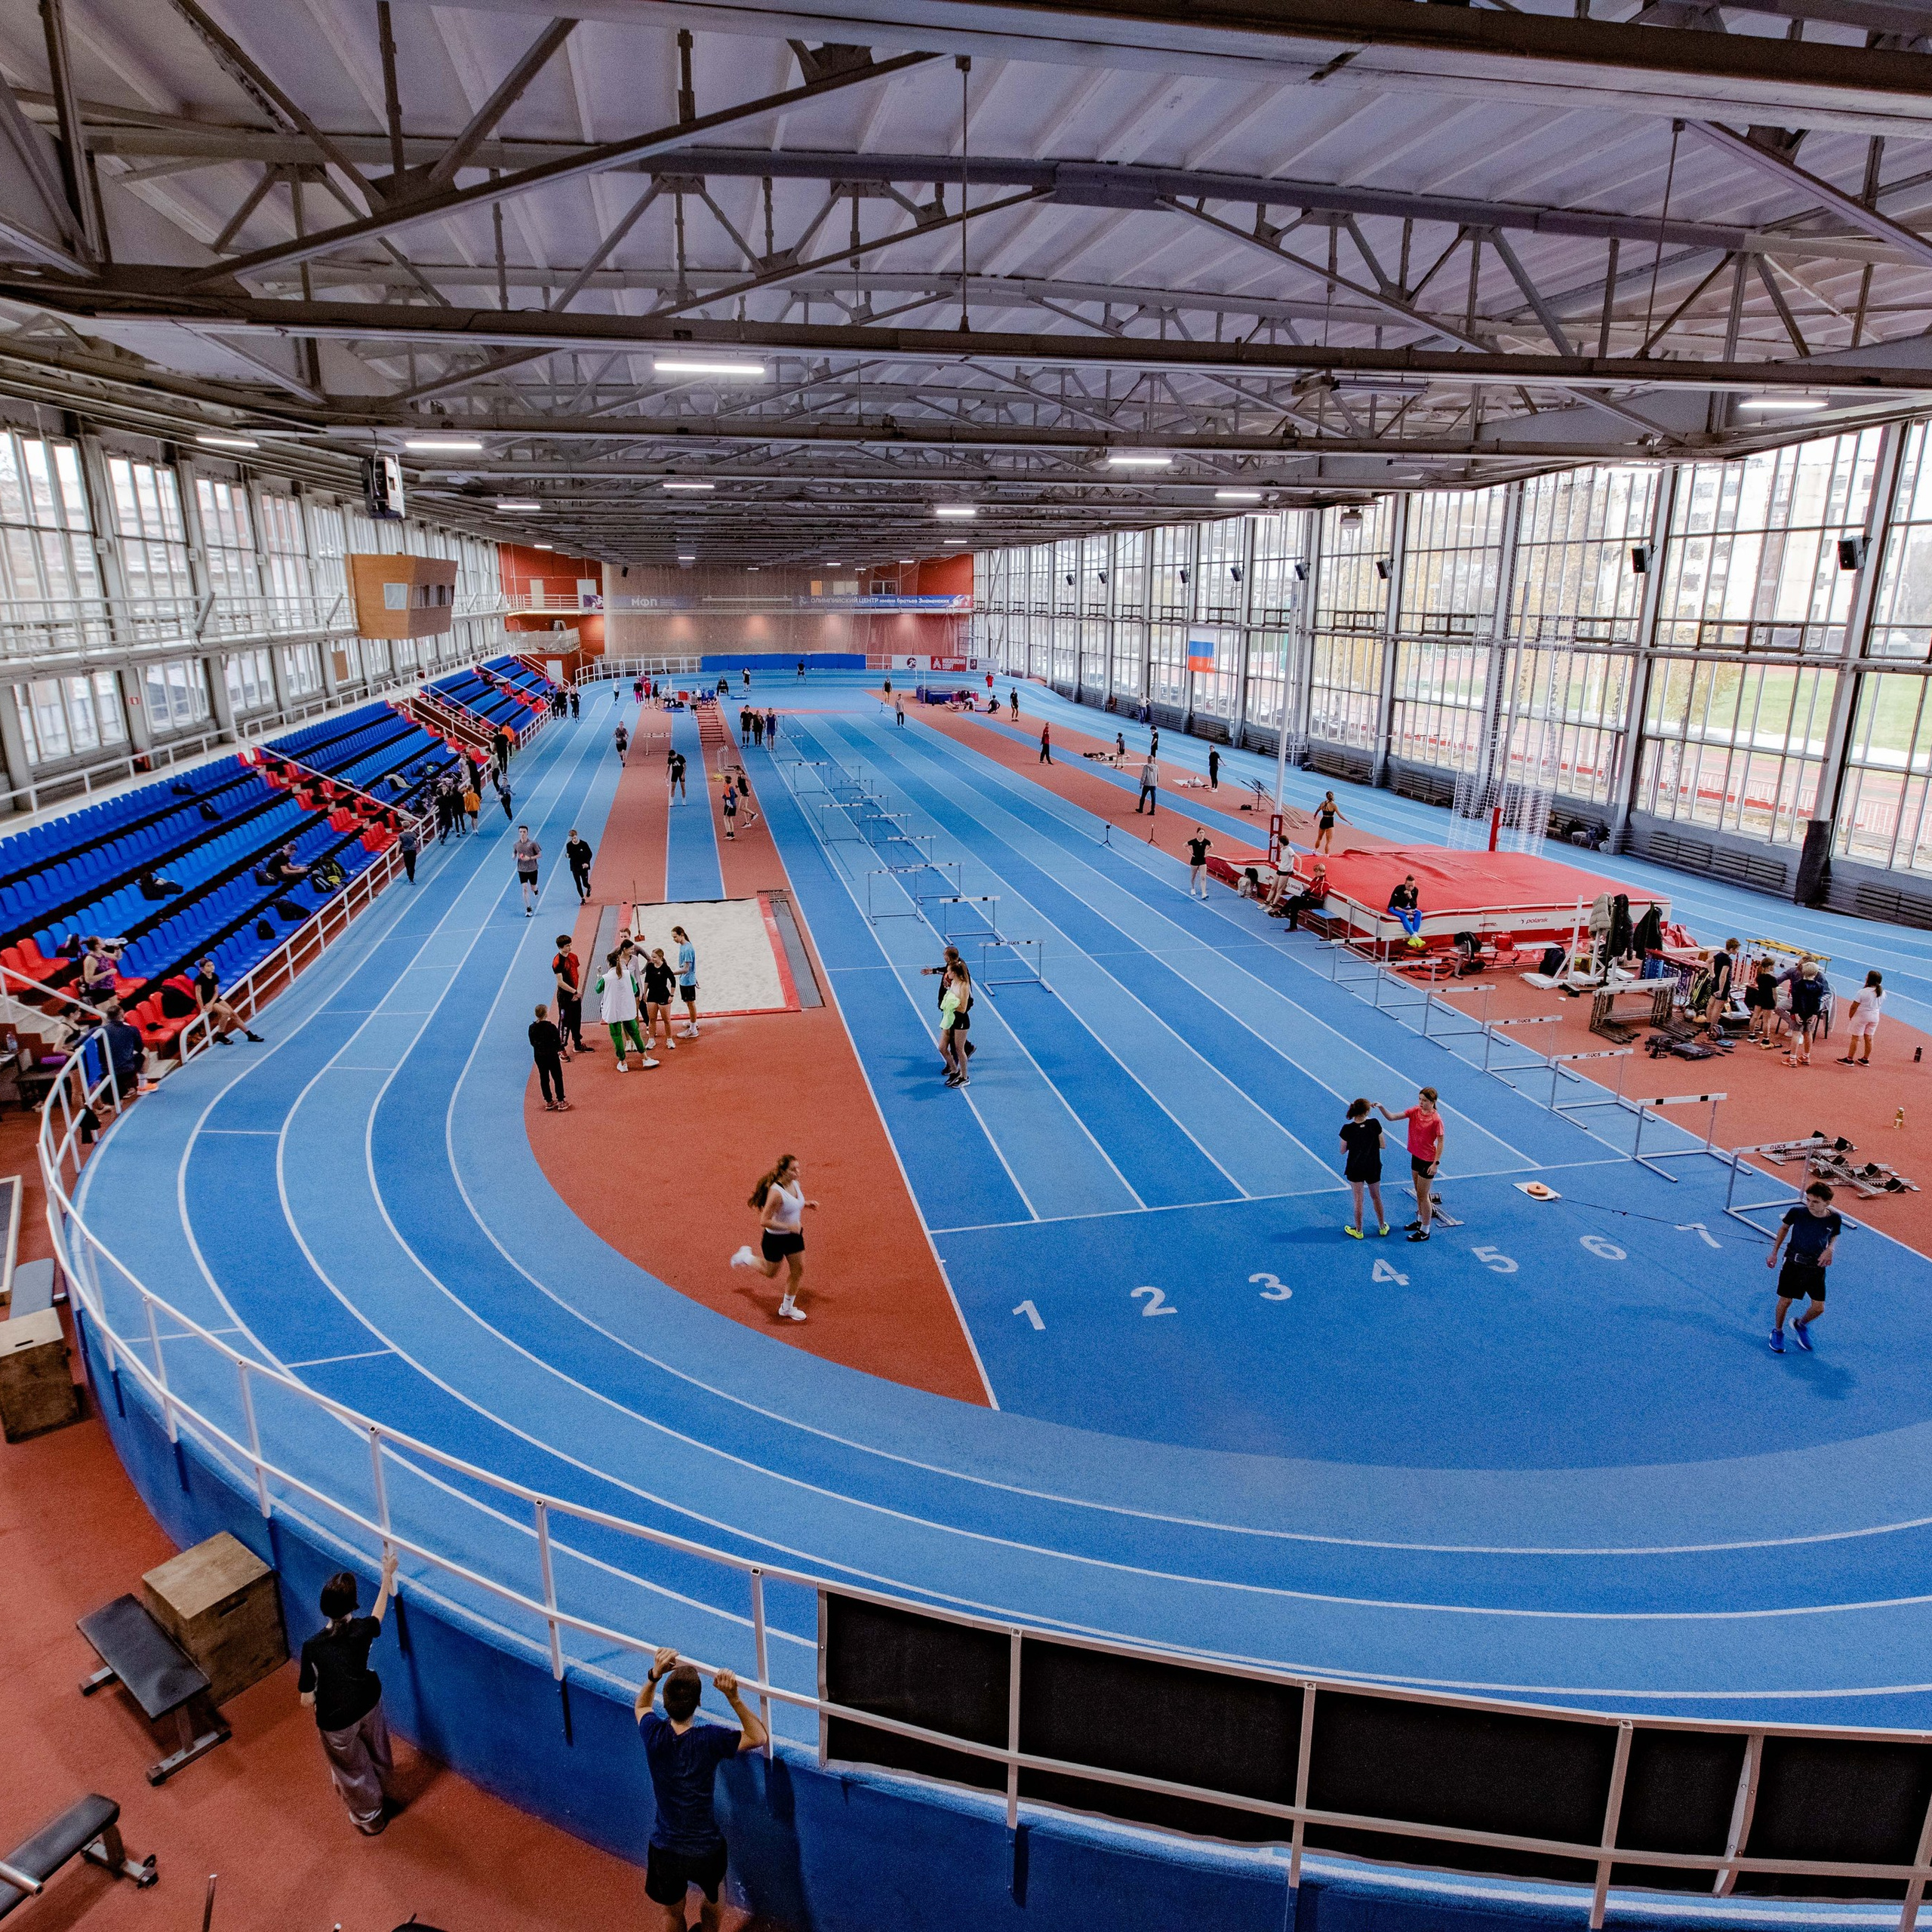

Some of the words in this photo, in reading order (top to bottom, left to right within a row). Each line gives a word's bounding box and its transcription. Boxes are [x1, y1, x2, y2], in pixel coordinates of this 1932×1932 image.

[1580, 1235, 1627, 1260] 6
[1673, 1223, 1723, 1248] 7
[1371, 1259, 1410, 1286] 4
[1471, 1246, 1518, 1273] 5
[1248, 1273, 1293, 1300] 3
[1131, 1286, 1178, 1317] 2
[1012, 1300, 1046, 1331] 1
